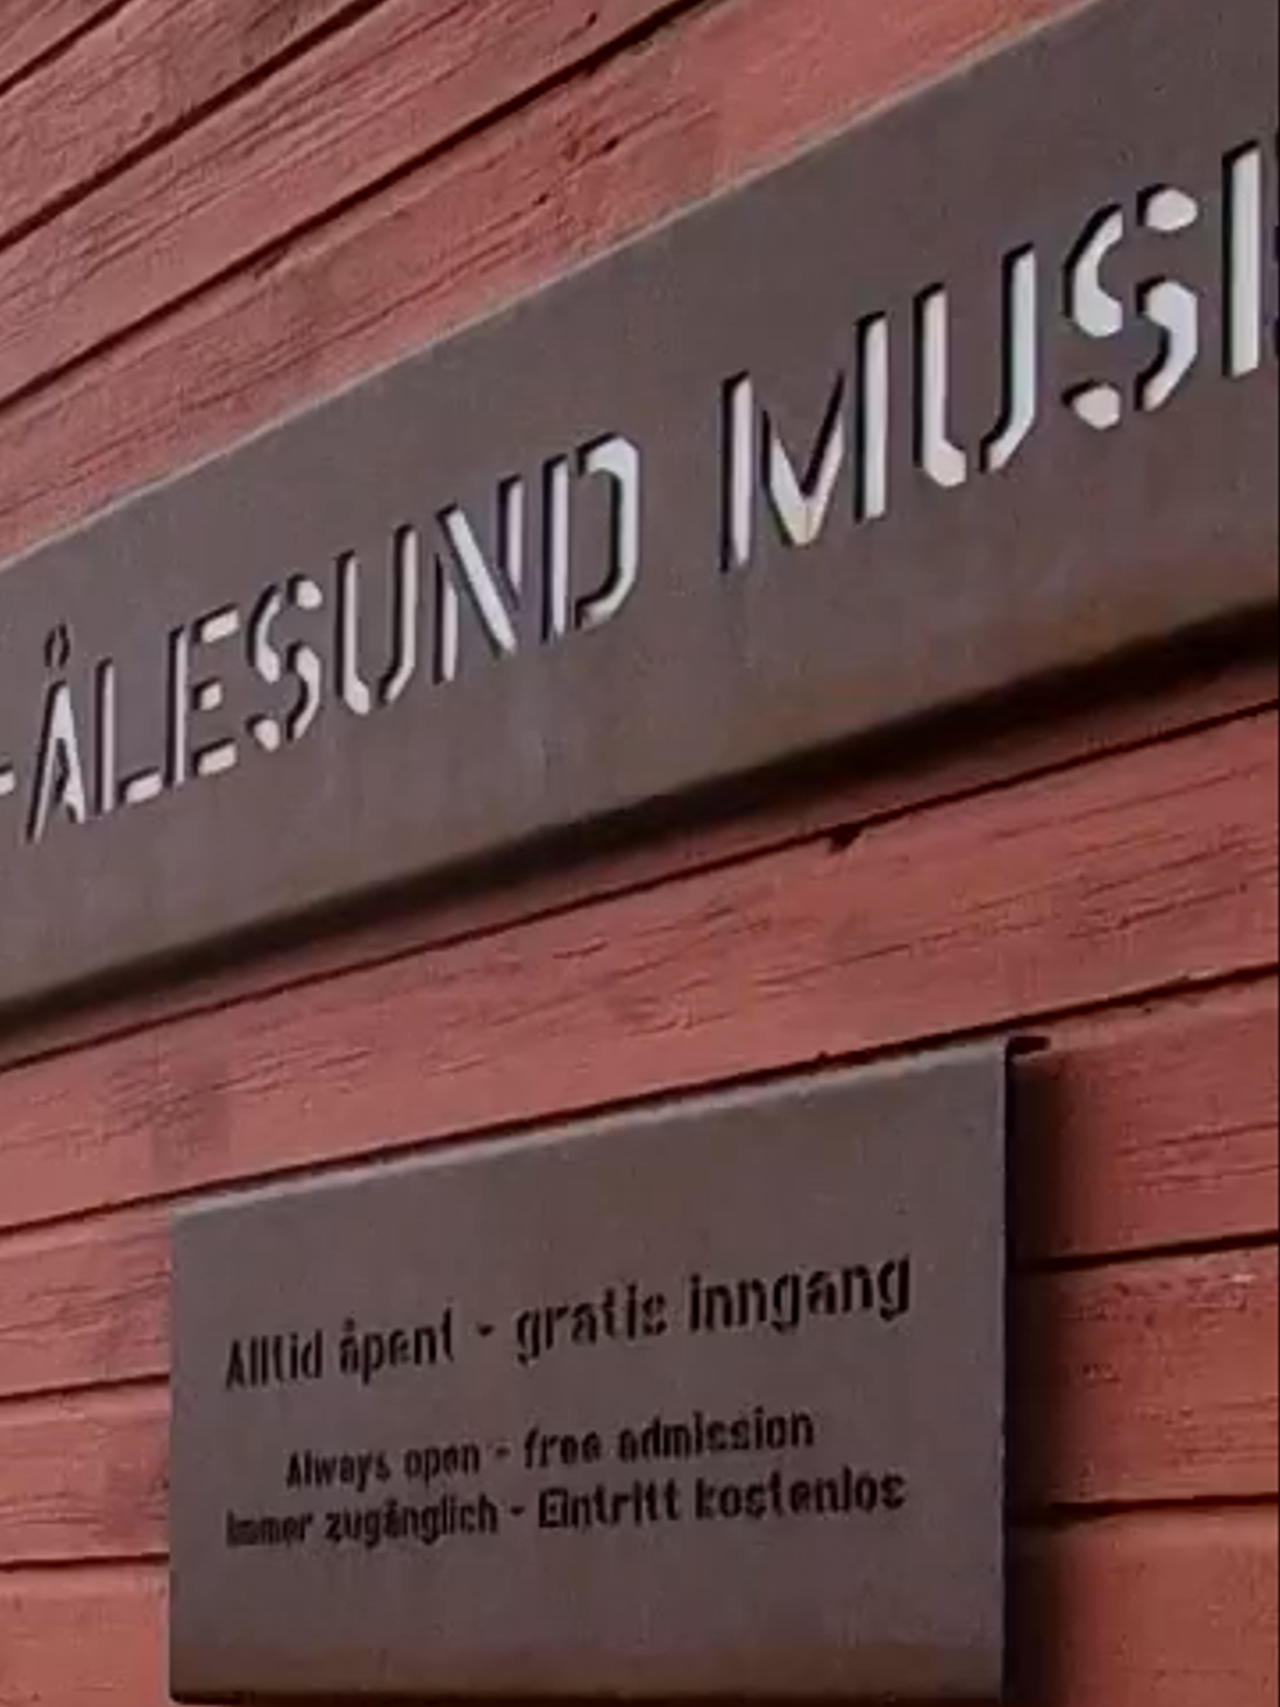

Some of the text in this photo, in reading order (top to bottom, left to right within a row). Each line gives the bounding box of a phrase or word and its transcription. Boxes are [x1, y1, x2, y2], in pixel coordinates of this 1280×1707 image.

[226, 1329, 323, 1389] Alltid
[339, 1307, 454, 1385] åpent
[516, 1281, 668, 1366] gratis
[691, 1254, 910, 1334] inngang
[287, 1449, 391, 1493] Always
[403, 1441, 480, 1487] open
[523, 1427, 601, 1468] free
[618, 1406, 815, 1462] admission
[325, 1493, 498, 1548] zugänglich
[539, 1478, 680, 1528] Eintritt
[695, 1465, 906, 1519] kostenlos
